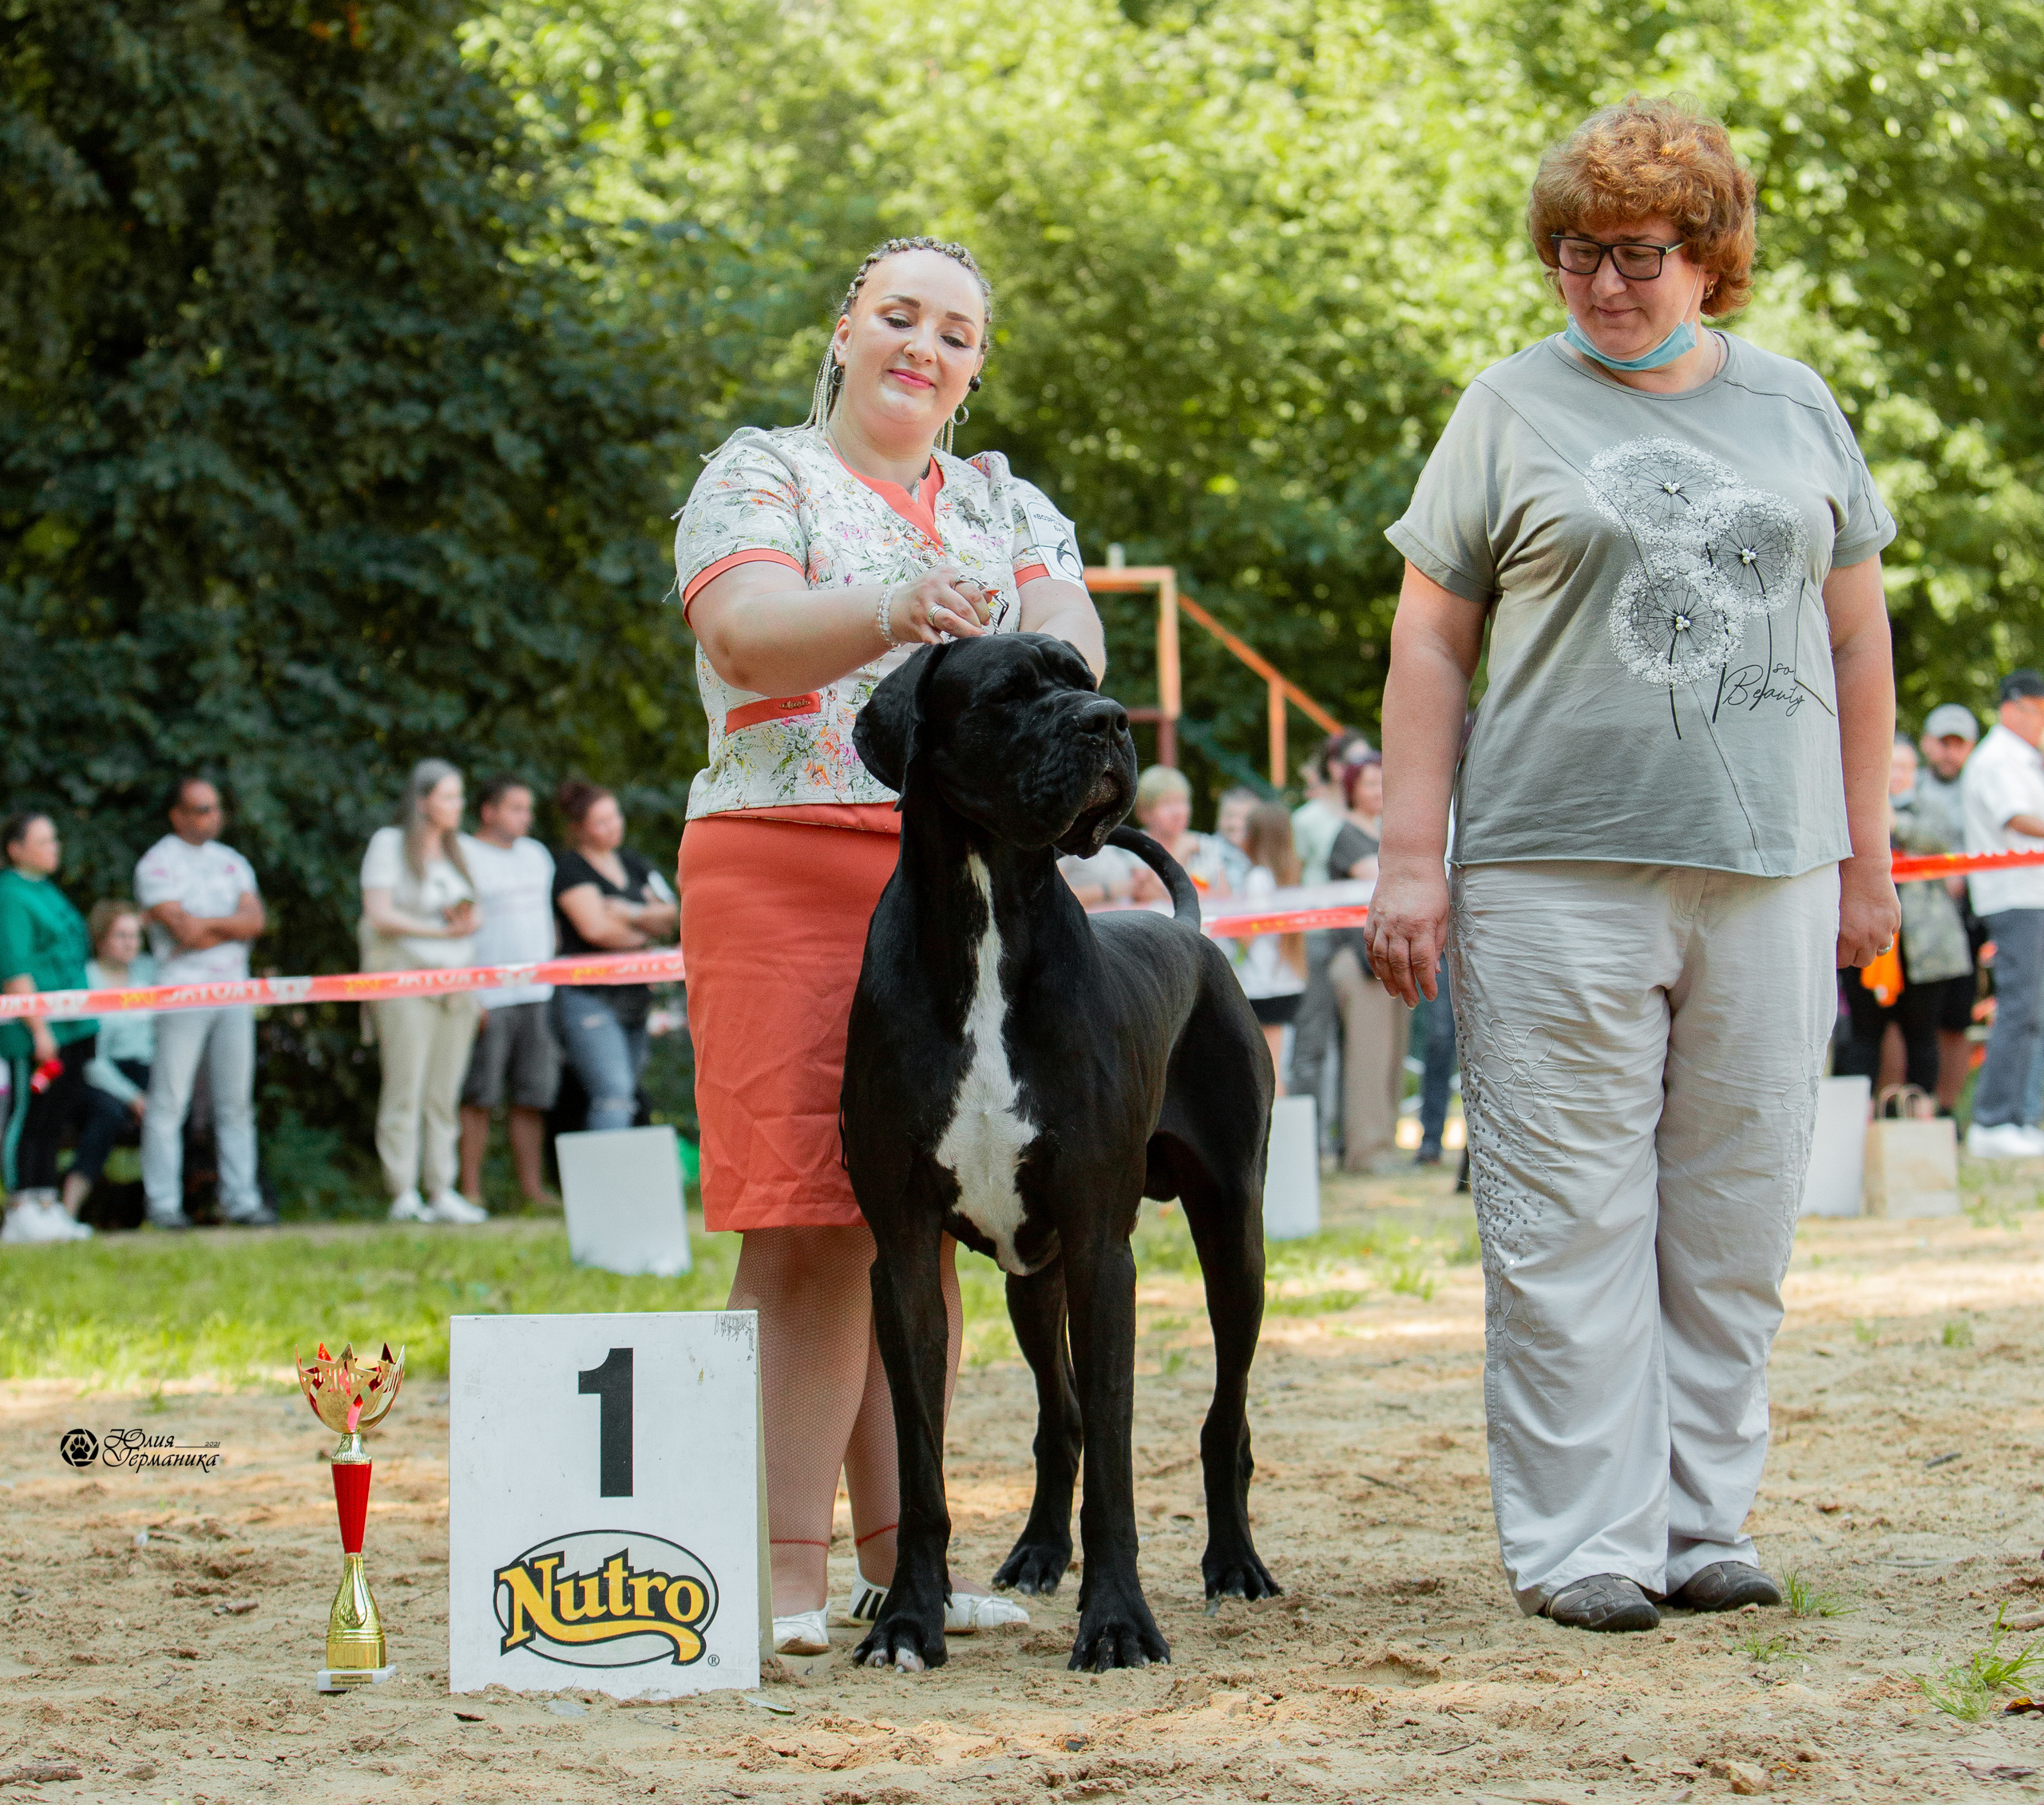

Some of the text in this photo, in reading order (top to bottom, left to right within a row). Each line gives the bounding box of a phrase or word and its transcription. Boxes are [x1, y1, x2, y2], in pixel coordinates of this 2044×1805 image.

[1722, 664, 1805, 717] Beauty
[1772, 663, 1794, 675] so
[578, 1347, 634, 1498] 1
[493, 1547, 711, 1667] Nutro
